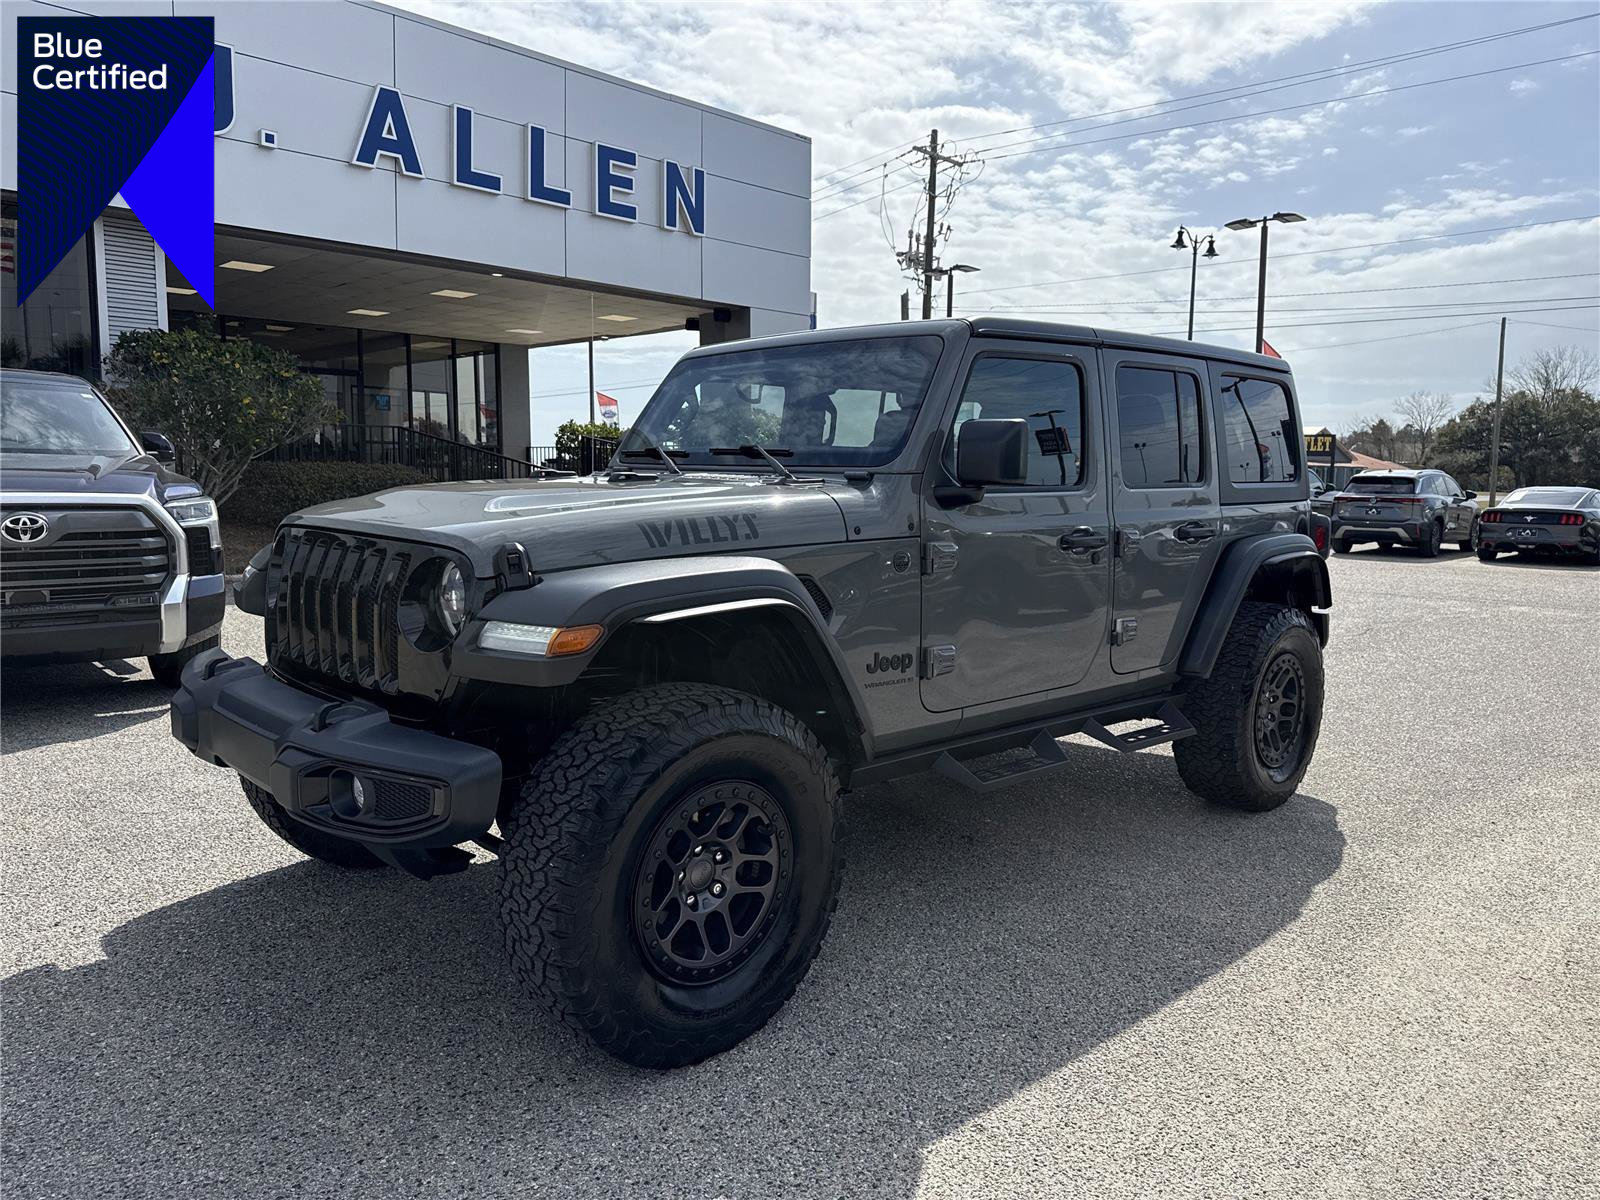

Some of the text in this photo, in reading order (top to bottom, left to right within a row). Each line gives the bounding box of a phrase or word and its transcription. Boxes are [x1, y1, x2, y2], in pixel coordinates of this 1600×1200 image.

[351, 84, 706, 236] ALLEN
[636, 512, 760, 548] WILLYS
[866, 652, 913, 674] Jeep
[864, 678, 907, 689] WRANGLER
